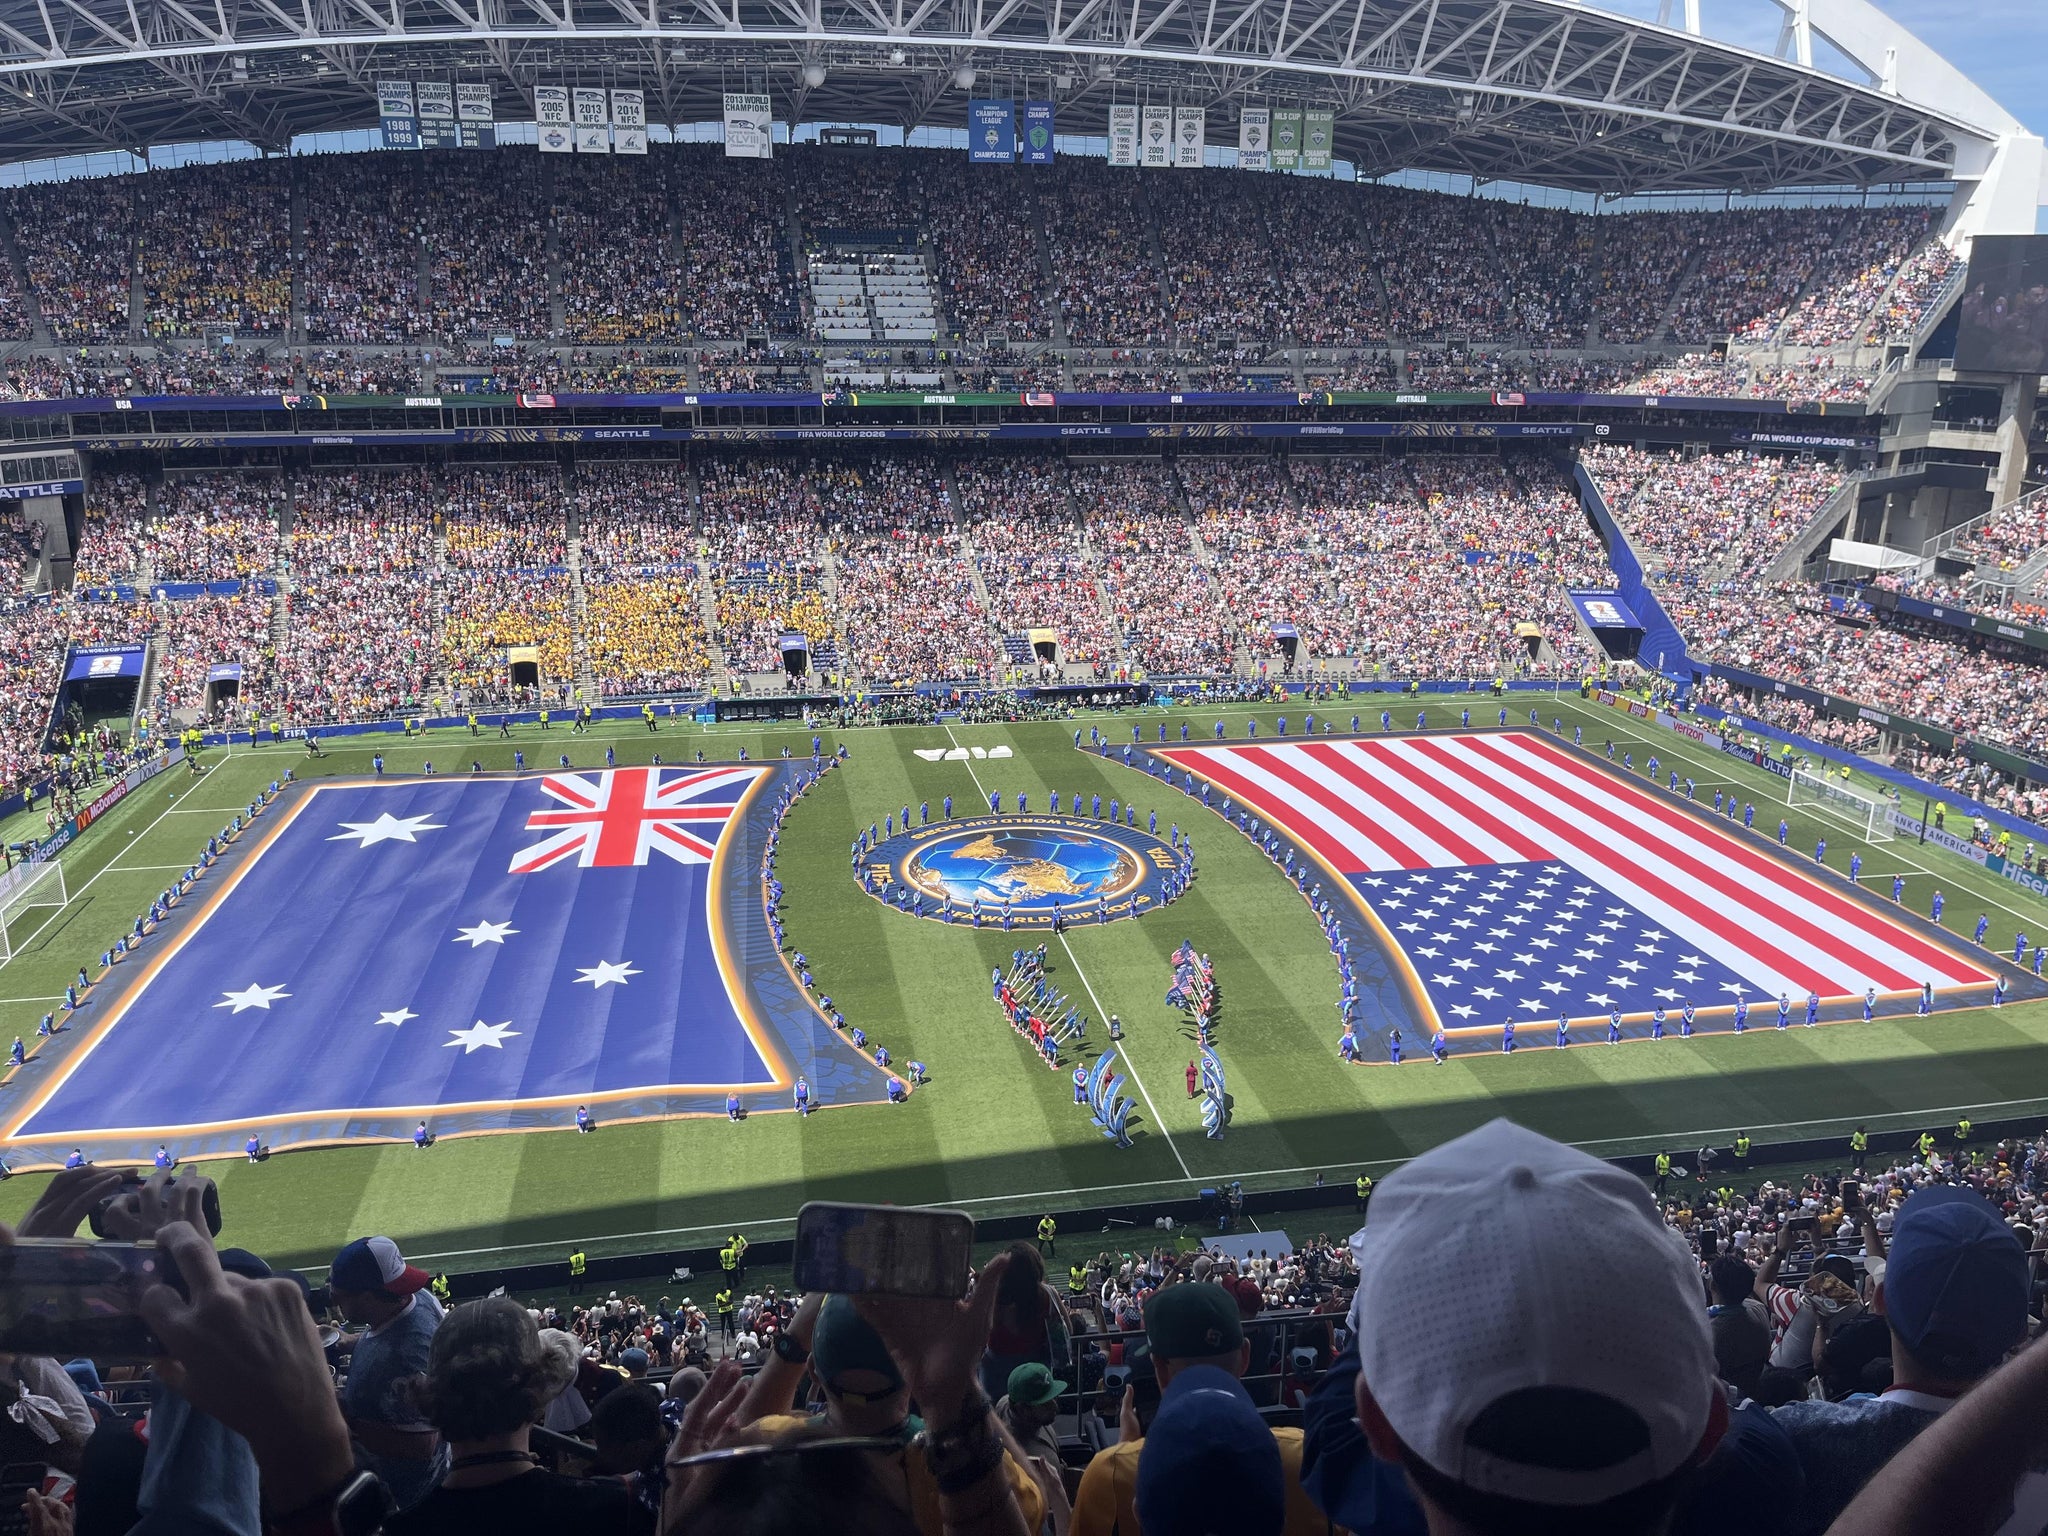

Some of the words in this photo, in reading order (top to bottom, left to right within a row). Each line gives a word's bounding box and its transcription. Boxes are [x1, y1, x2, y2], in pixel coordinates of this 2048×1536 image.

[380, 90, 411, 98] CHAMPS
[420, 92, 451, 100] CHAMPS
[744, 96, 768, 104] WORLD
[541, 102, 563, 112] 2005
[580, 104, 602, 114] 2013
[618, 106, 640, 115] 2014
[726, 104, 769, 112] CHAMPIONS
[386, 121, 410, 130] 1988
[388, 133, 412, 143] 1999
[727, 135, 758, 144] XLVIII
[116, 400, 132, 409] USA
[405, 398, 442, 406] AUSTRALIA
[1771, 435, 1803, 443] WORLD
[1823, 438, 1855, 446] 2026
[1971, 618, 1976, 627] V
[1775, 682, 1786, 693] USA
[1824, 696, 1829, 706] V
[1858, 707, 1889, 724] AUSTRALIA
[1727, 715, 1742, 726] FIFA
[284, 729, 308, 738] FIFA
[1673, 721, 1704, 742] verizon
[1722, 741, 1754, 762] Michelob
[139, 764, 158, 783] Dove
[90, 782, 126, 819] McDonald's
[1066, 820, 1101, 830] FIFA
[911, 823, 964, 840] 2026
[1888, 812, 1913, 830] BANK
[1929, 829, 1972, 857] AMERICA
[29, 829, 70, 863] Hisense
[1146, 847, 1176, 869] FIFA
[871, 864, 894, 886] FIFA
[934, 908, 975, 920] FFA
